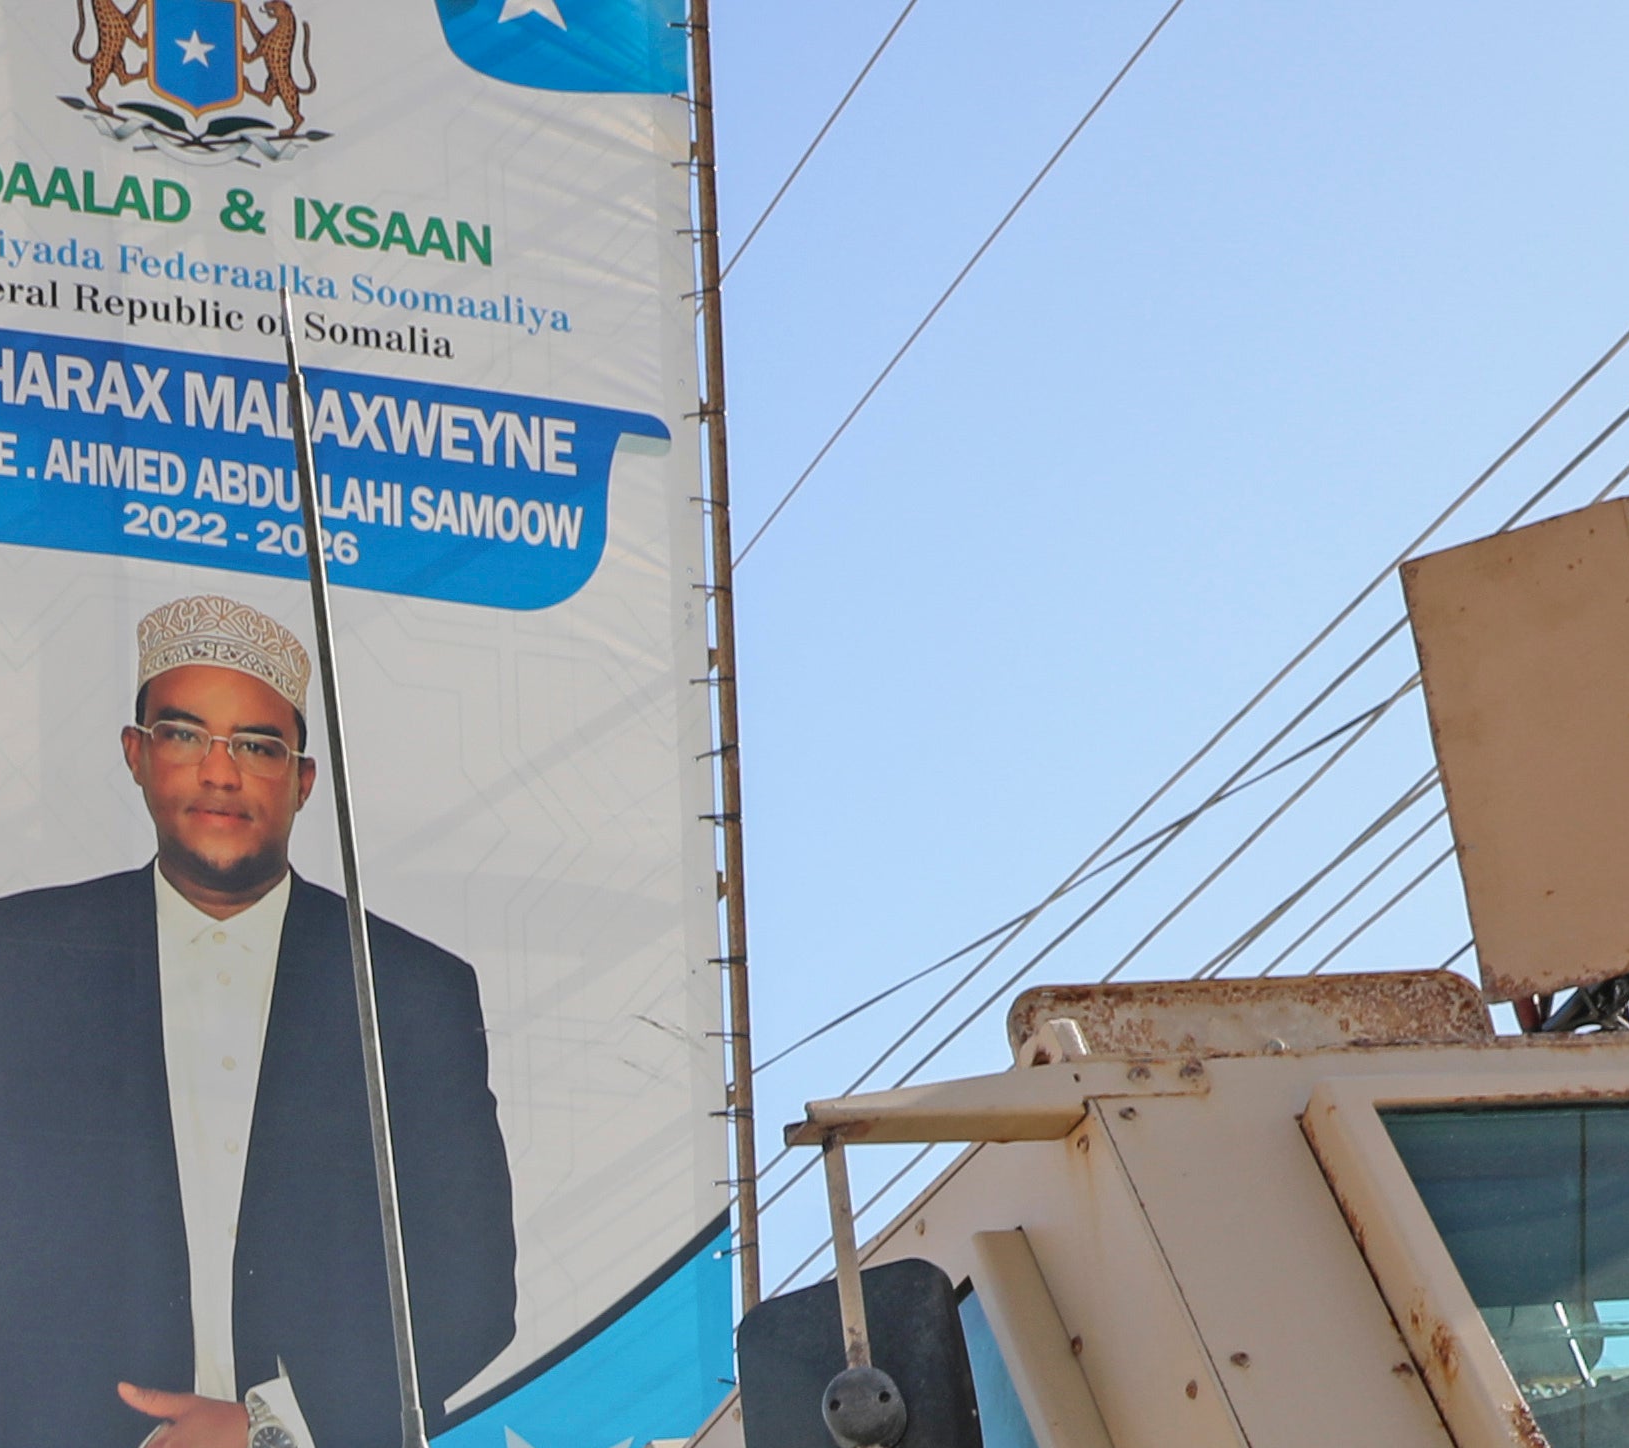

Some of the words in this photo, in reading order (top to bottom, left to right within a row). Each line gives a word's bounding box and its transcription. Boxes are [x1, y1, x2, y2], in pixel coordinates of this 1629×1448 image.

[220, 188, 266, 234] &
[294, 197, 493, 267] IXSAAN
[73, 283, 244, 331] Republic
[304, 311, 456, 360] Somalia
[118, 244, 339, 300] Federaalka
[352, 273, 572, 335] Soomaaliya
[184, 371, 578, 476] MADAXWEYNE
[43, 438, 187, 496] AHMED
[194, 457, 403, 528] ABDULAHI
[410, 485, 583, 551] SAMOOW
[123, 502, 228, 548] 2022
